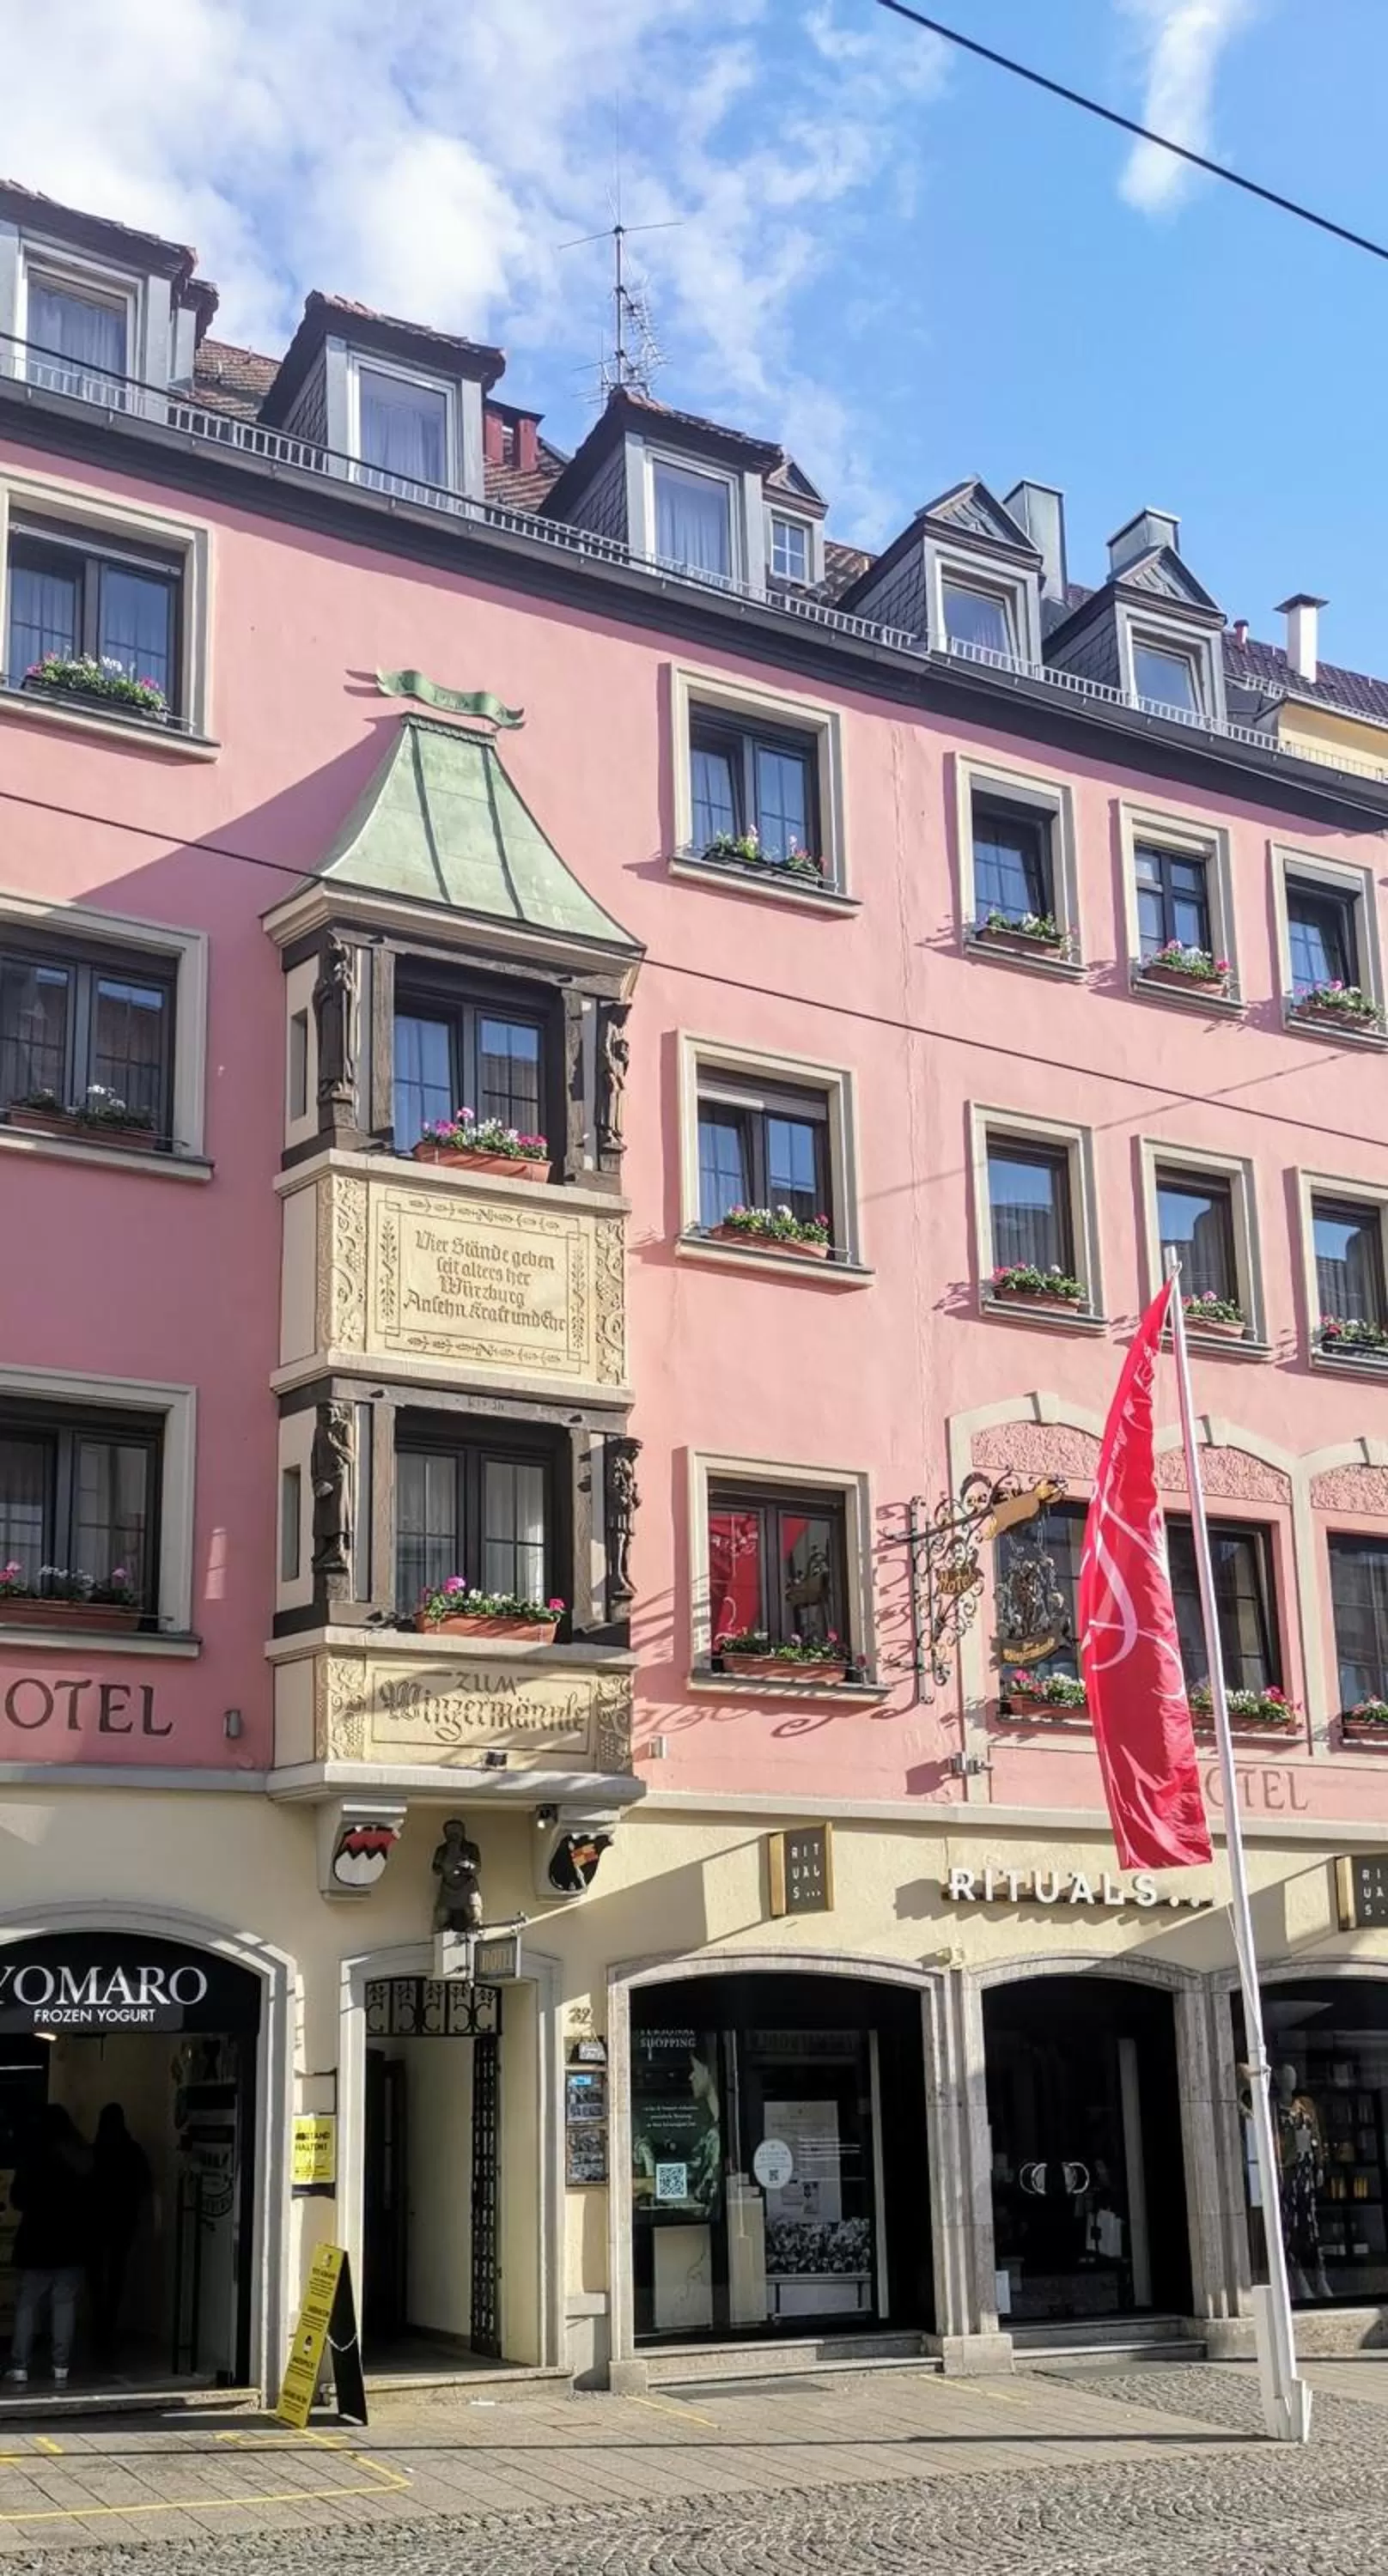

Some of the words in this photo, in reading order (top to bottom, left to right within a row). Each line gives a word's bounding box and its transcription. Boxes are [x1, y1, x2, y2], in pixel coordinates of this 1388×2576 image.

[416, 1230, 449, 1254] Vier
[452, 1236, 510, 1263] Stände
[511, 1250, 555, 1270] geben
[440, 1275, 525, 1309] Würzburg
[4, 1678, 174, 1736] OTEL
[1204, 1766, 1309, 1811] OTEL
[791, 1842, 819, 1859] RIT
[792, 1864, 821, 1880] UAL
[1361, 1867, 1382, 1881] RI
[1363, 1886, 1385, 1899] UA
[33, 2008, 92, 2023] FROZEN
[97, 2008, 157, 2023] YOGURT
[640, 2038, 697, 2048] SHOPPING
